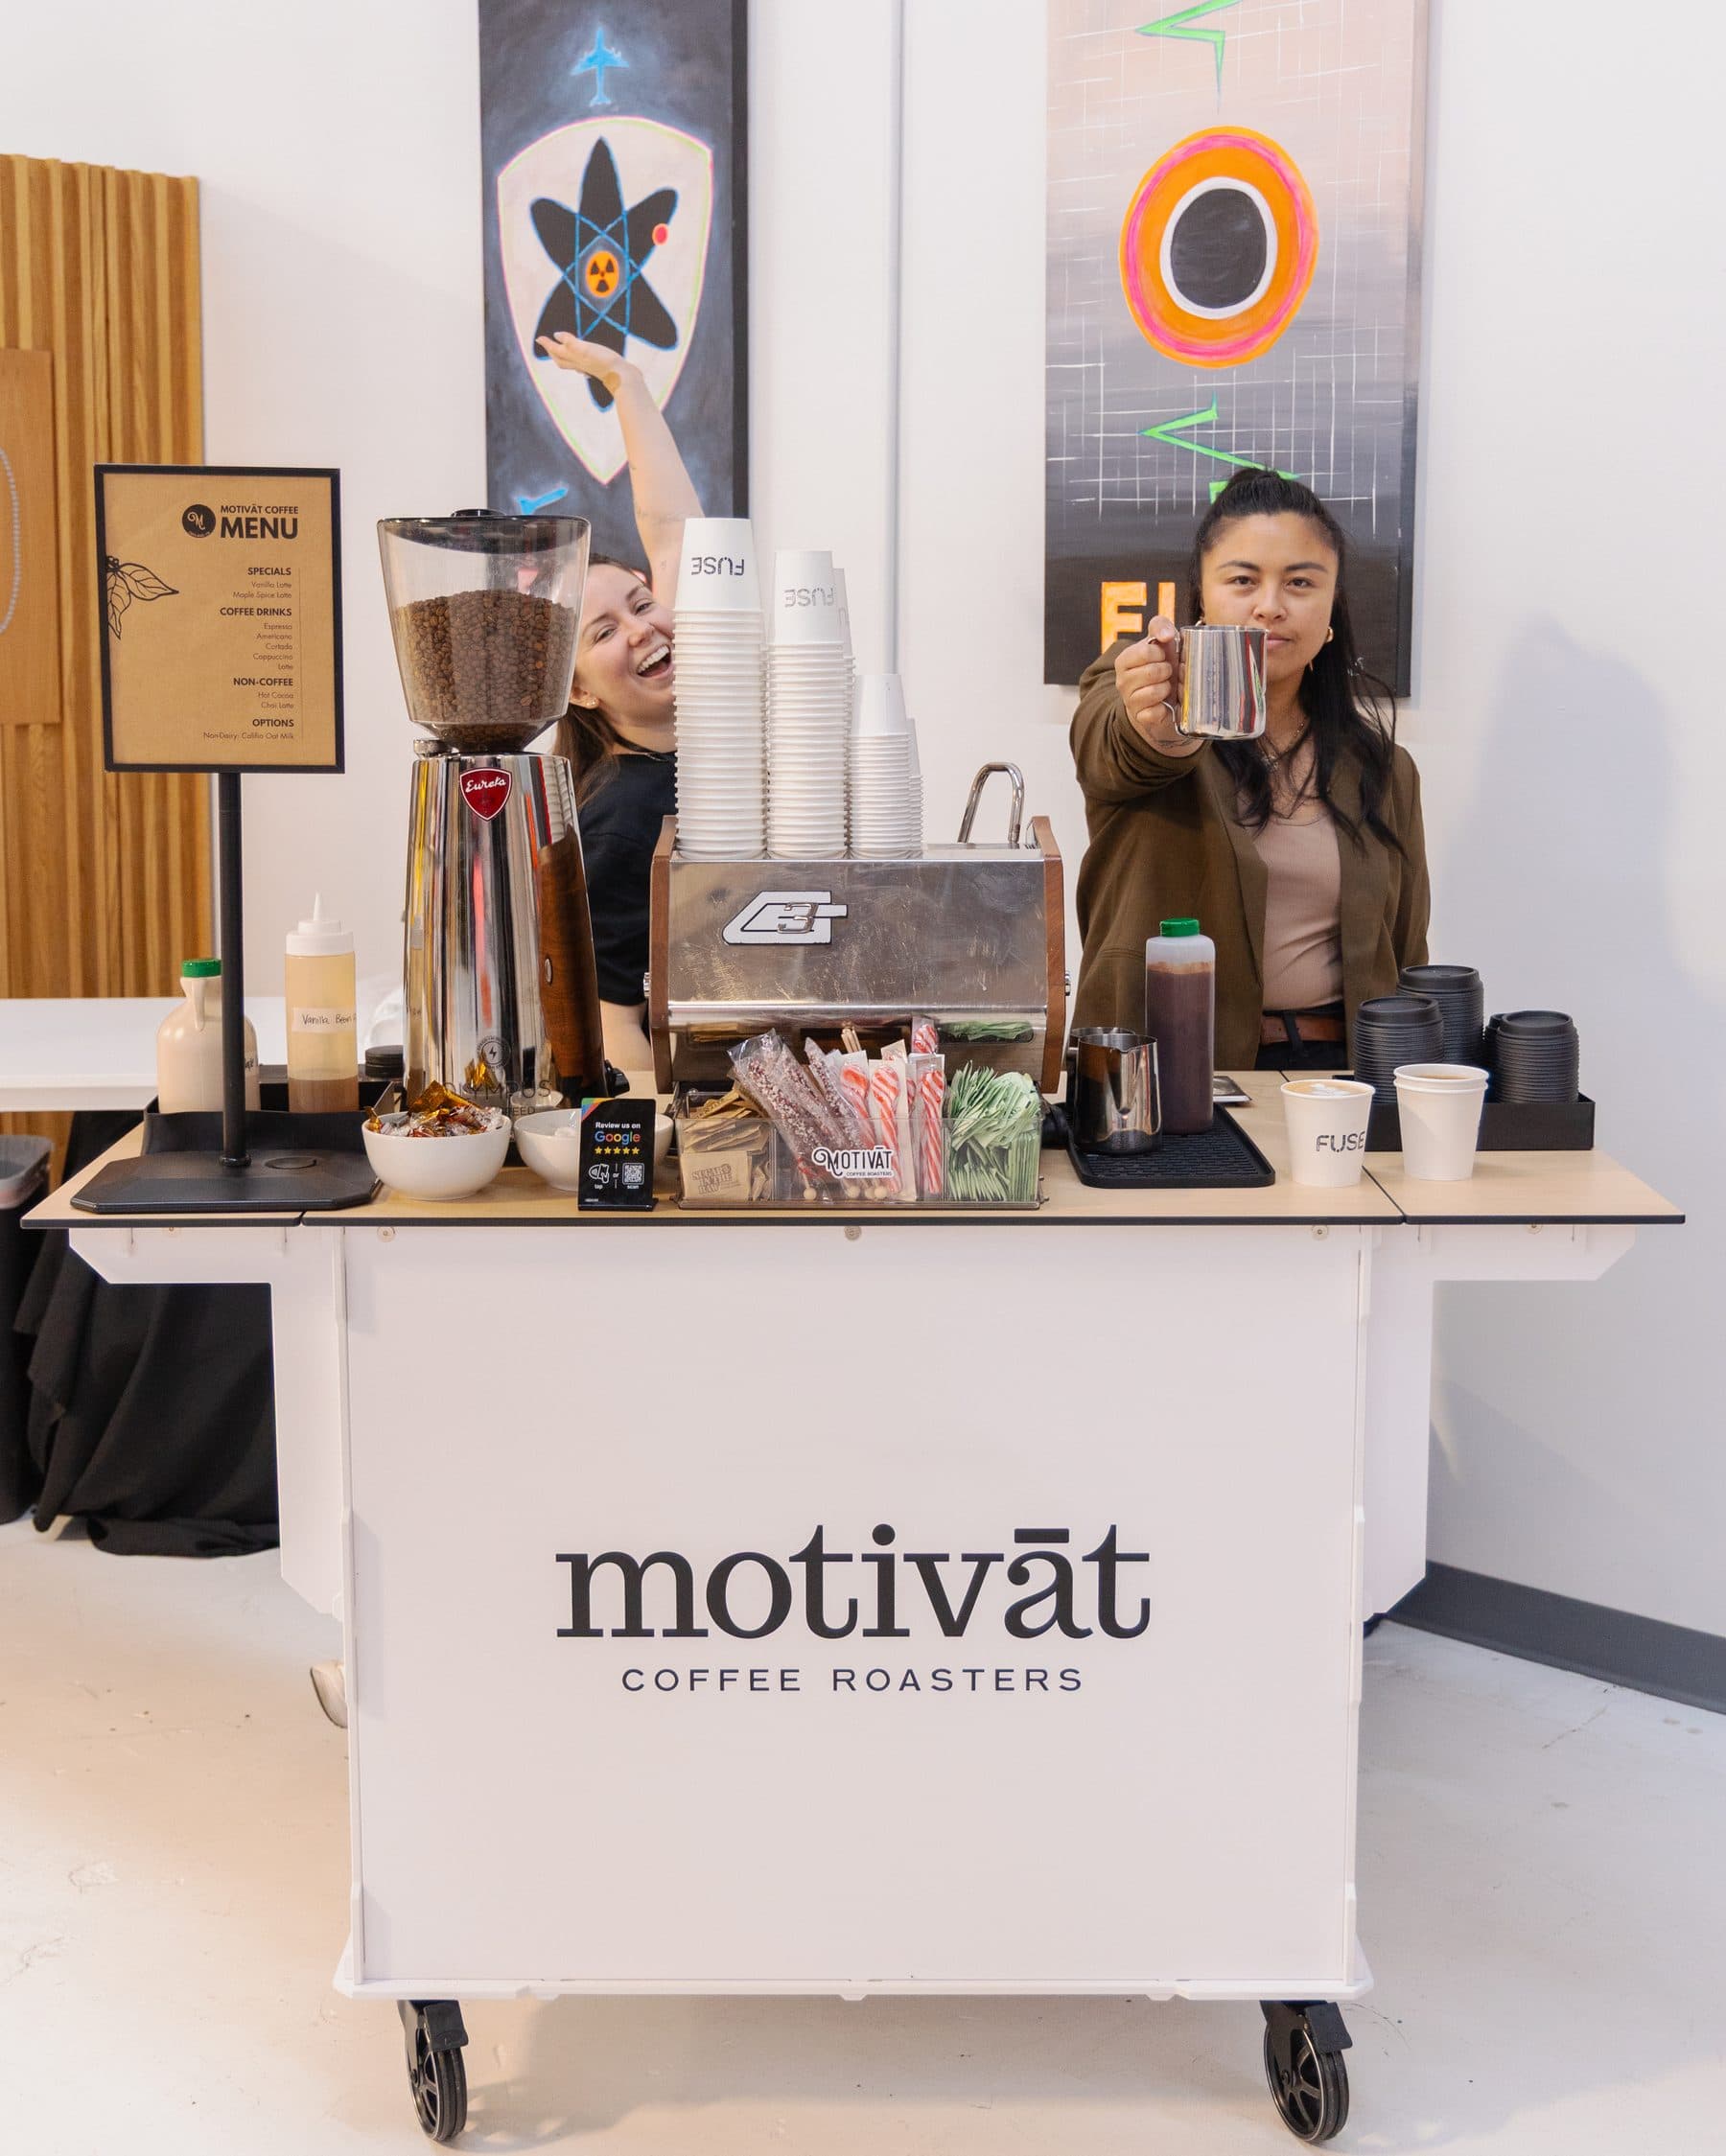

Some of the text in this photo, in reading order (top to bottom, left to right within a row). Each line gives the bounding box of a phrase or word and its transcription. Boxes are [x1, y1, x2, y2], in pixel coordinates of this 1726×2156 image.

[265, 506, 298, 515] COFFEE
[220, 517, 298, 540] MENU
[247, 567, 292, 576] SPECIALS
[690, 556, 745, 576] FUSE
[232, 591, 254, 600] Maple
[255, 591, 275, 600] Spice
[783, 587, 835, 608] FUSE
[220, 607, 292, 616] COFFEE DRINKS
[264, 622, 292, 632] Espresso
[252, 653, 293, 661] Cappuccino
[233, 677, 293, 686] NON-COFFEE
[252, 718, 294, 728] OPTIONS
[465, 776, 506, 793] Eureka
[595, 1131, 641, 1146] Google
[1316, 1130, 1365, 1152] FUSE
[555, 1523, 1151, 1639] motivāt
[621, 1668, 1084, 1692] COFFEE ROASTERS
